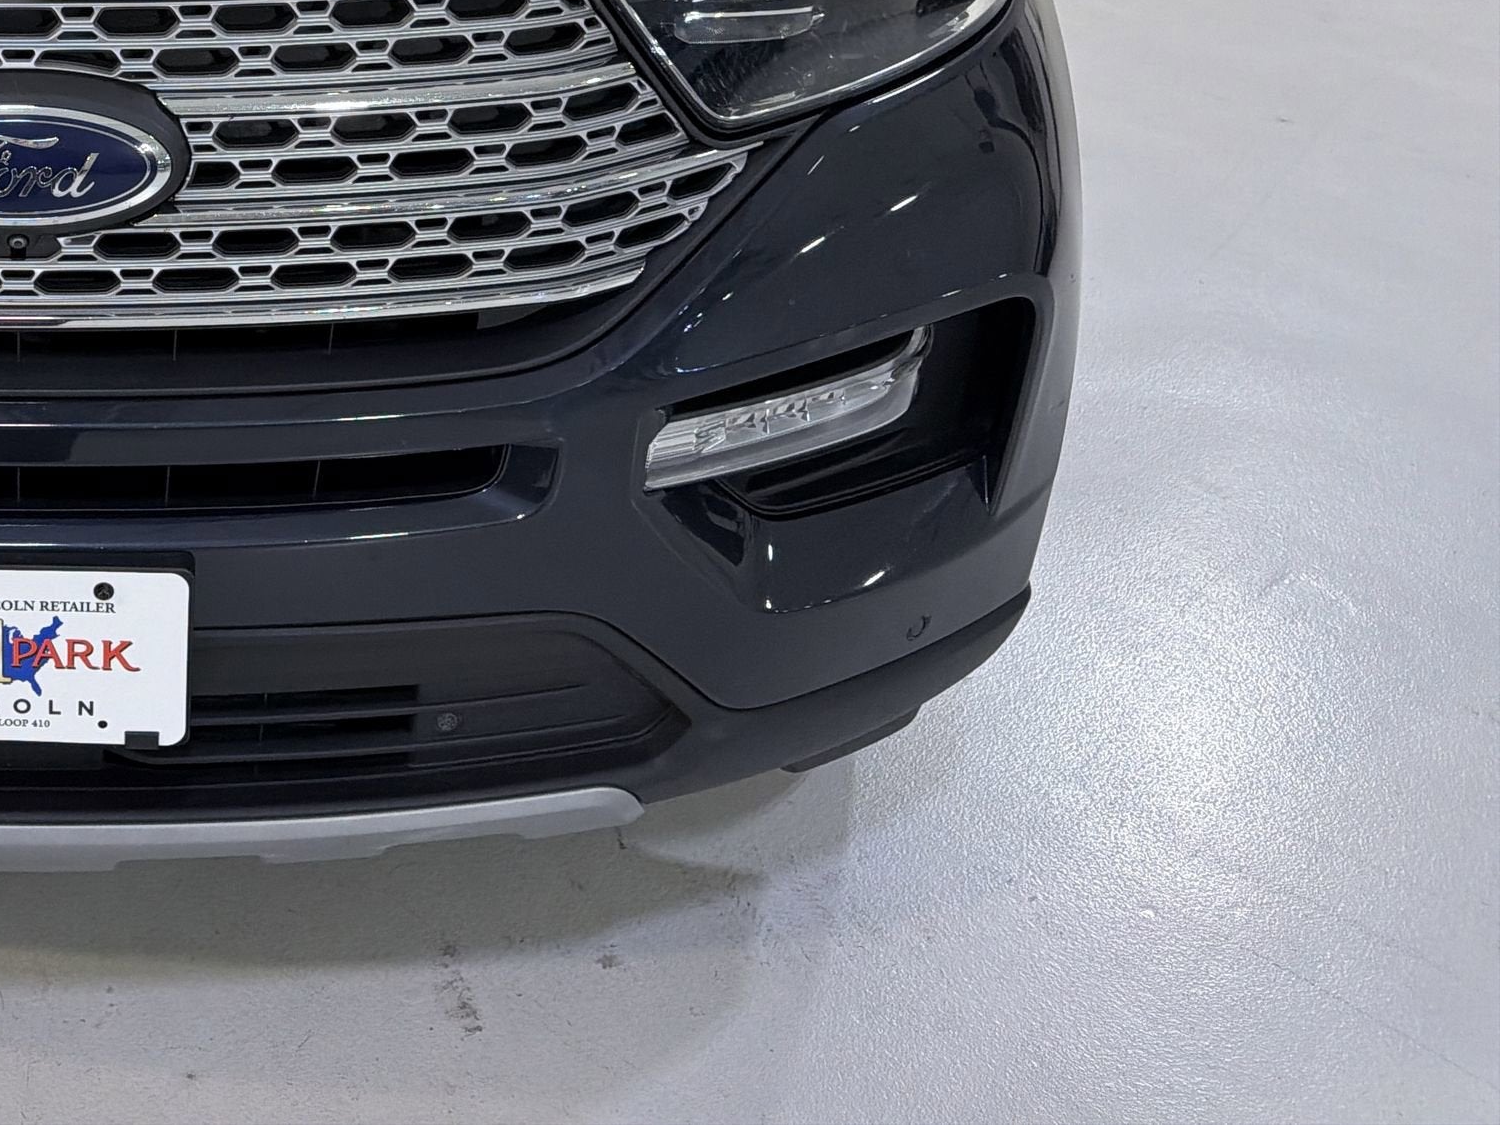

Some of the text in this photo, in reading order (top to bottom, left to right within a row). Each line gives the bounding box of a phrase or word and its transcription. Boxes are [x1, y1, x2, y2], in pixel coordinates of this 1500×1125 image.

[39, 600, 117, 614] RETAILER
[11, 637, 141, 672] PARK
[31, 718, 51, 728] 410
